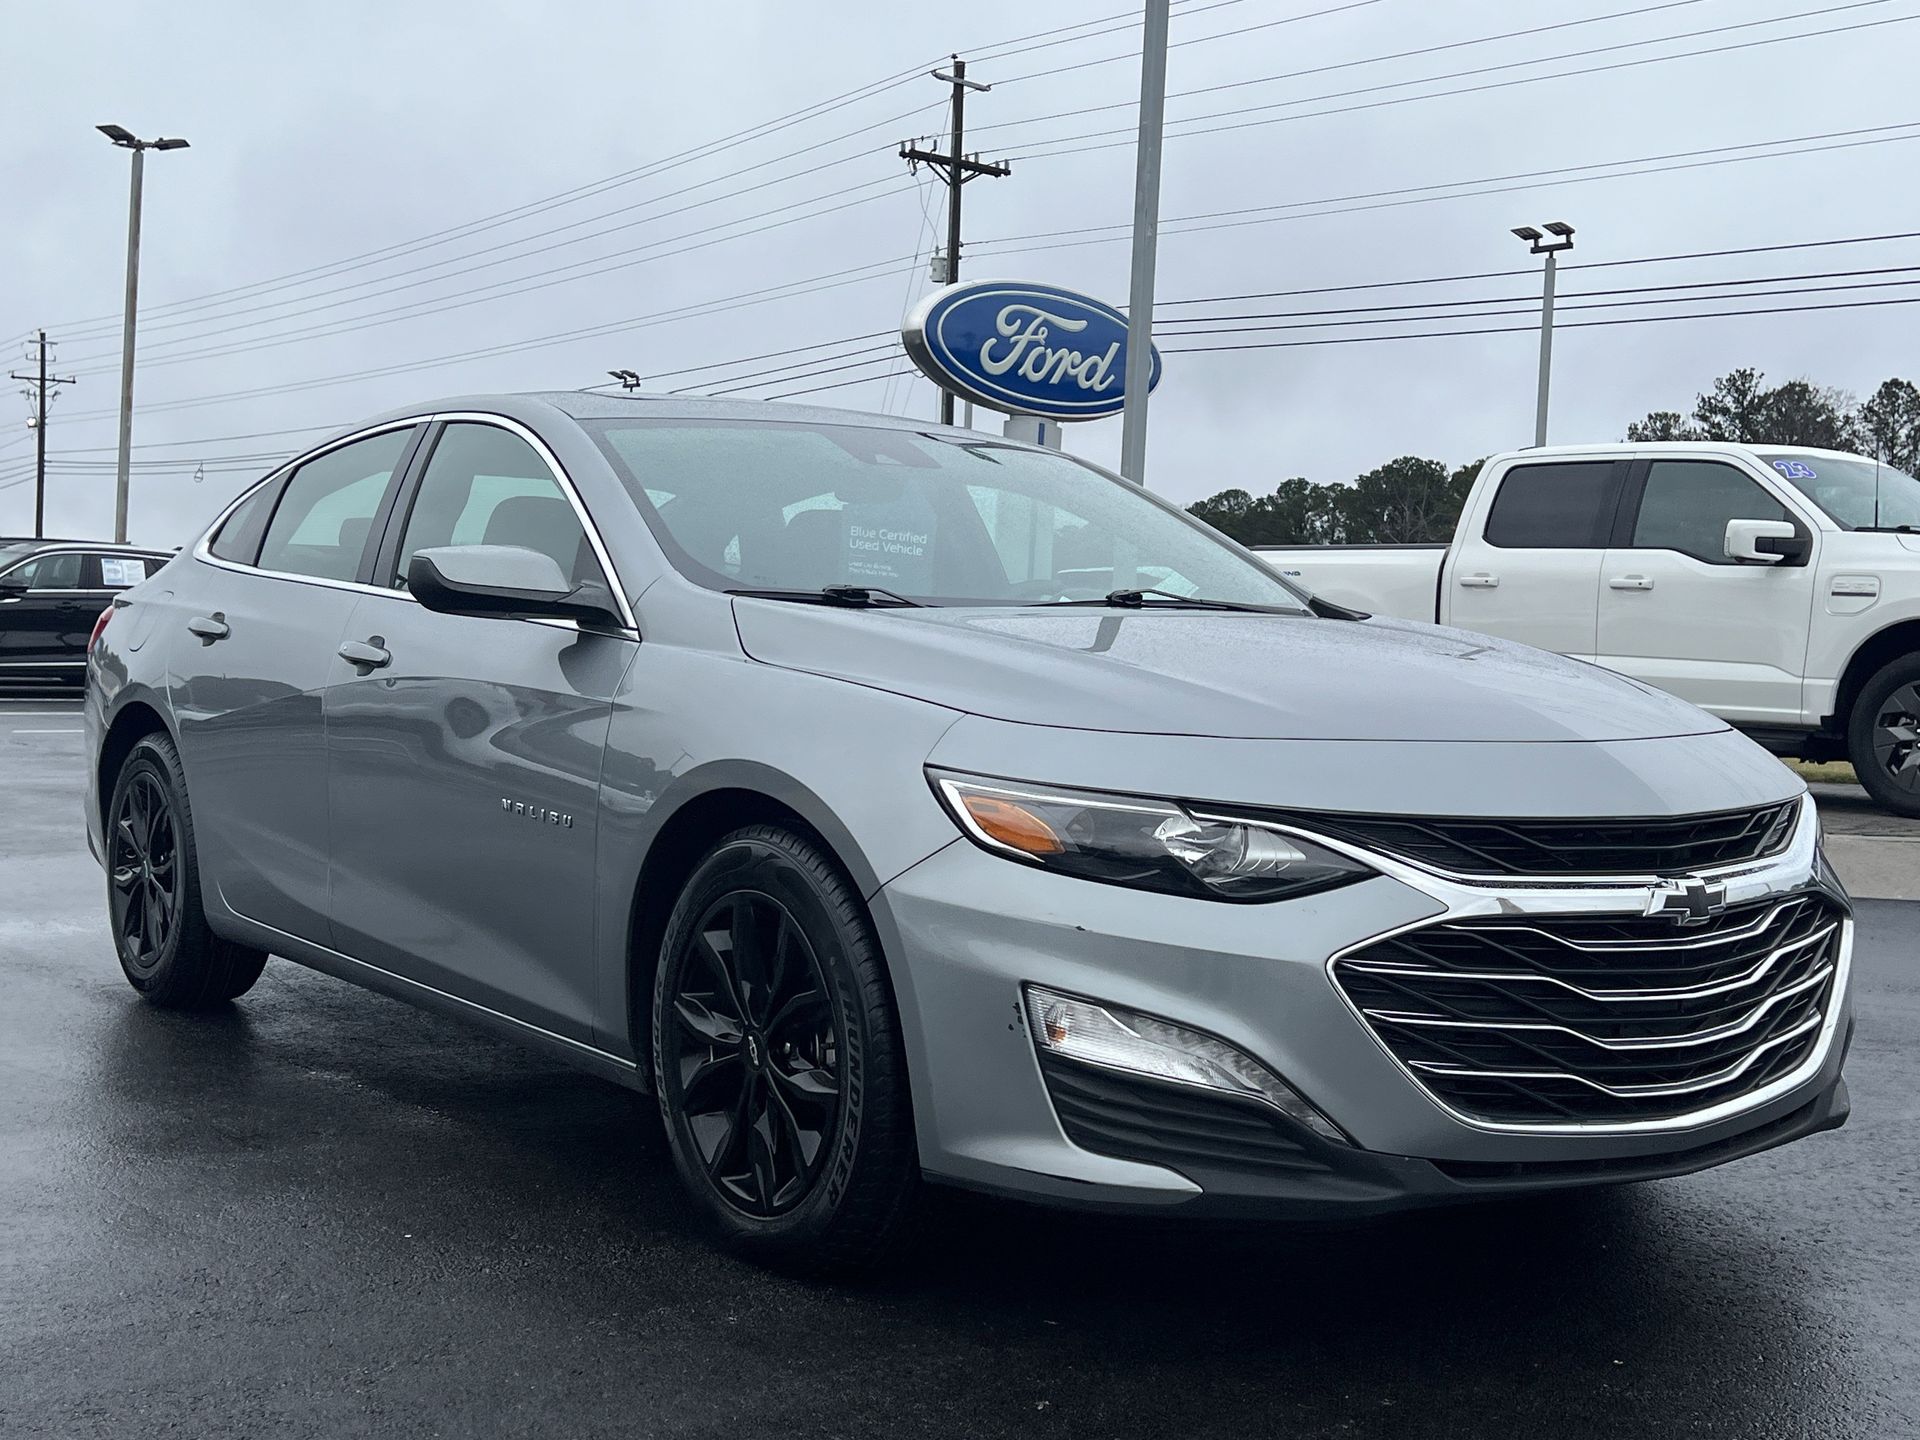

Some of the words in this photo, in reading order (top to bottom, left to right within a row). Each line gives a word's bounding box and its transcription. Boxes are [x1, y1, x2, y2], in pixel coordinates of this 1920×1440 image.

[979, 304, 1121, 392] Ford
[1773, 460, 1816, 478] 23
[850, 525, 877, 539] Blue
[879, 529, 928, 544] Certified
[849, 538, 880, 552] Used
[882, 541, 924, 556] Vehicle
[501, 797, 573, 828] MALIBU
